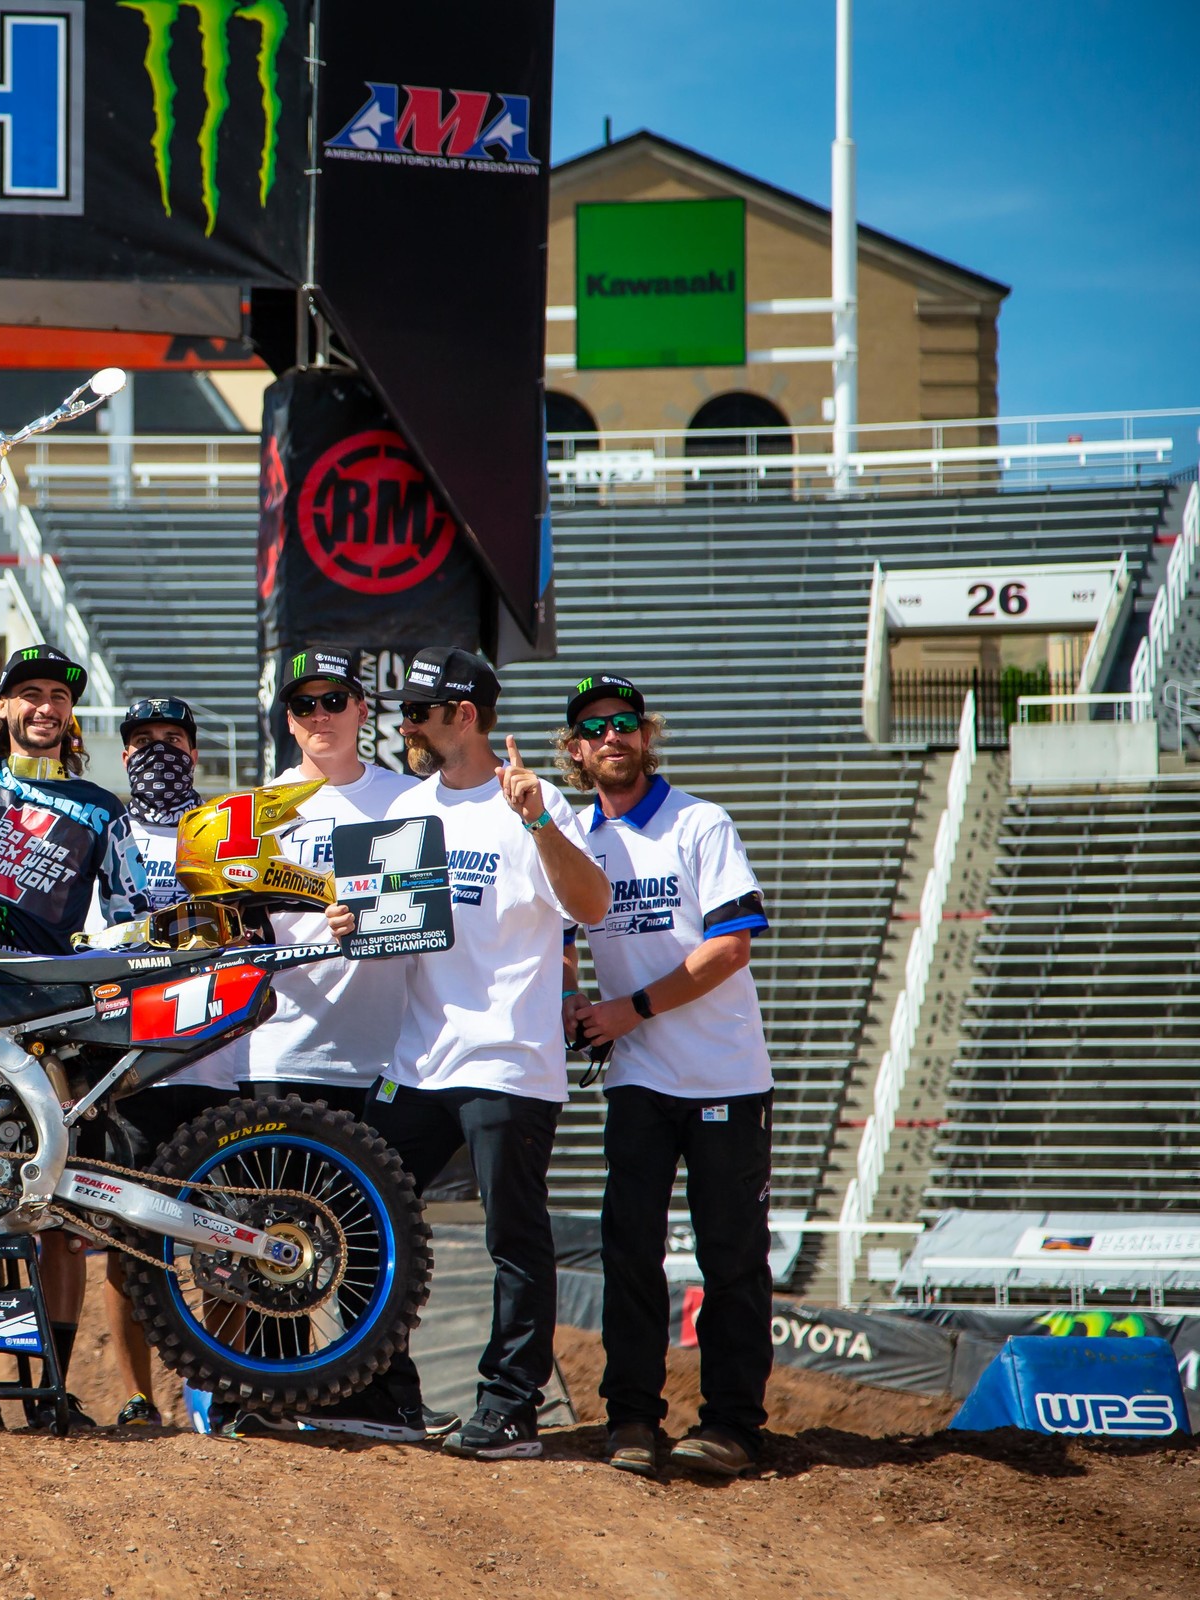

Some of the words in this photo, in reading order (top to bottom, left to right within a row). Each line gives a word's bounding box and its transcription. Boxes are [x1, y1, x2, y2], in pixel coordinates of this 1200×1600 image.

[323, 81, 541, 164] AMA
[324, 148, 381, 164] AMERICAN
[383, 152, 466, 170] MOTORCYCLIST
[468, 158, 540, 176] ASSOCIATION
[586, 269, 736, 298] Kawasaki
[968, 583, 1029, 617] 26
[324, 655, 349, 666] YAMAHA
[418, 660, 441, 674] YAMAHA
[214, 792, 261, 863] 1
[24, 834, 71, 863] AMA
[314, 835, 333, 843] DYLA
[21, 850, 77, 884] WEST
[446, 849, 501, 874] ANDIS
[155, 878, 178, 888] WEST
[228, 868, 254, 879] BELL
[357, 818, 427, 935] 1
[342, 878, 378, 894] AMA
[610, 875, 679, 902] RANDIS
[613, 901, 638, 914] WEST
[379, 913, 407, 925] 2020
[646, 916, 671, 927] THOR
[350, 938, 368, 947] AMA
[368, 932, 422, 945] SUPERCROSS
[422, 929, 446, 940] 250SX
[350, 943, 383, 957] WEST
[385, 937, 447, 953] CHAMPION
[127, 956, 172, 969] YAMAHA
[274, 944, 342, 962] DUNL
[213, 956, 246, 971] Ferrandis
[163, 972, 218, 1035] 1
[207, 1000, 224, 1018] W
[218, 1122, 288, 1148] DUNLOP
[73, 1174, 123, 1195] BRAKING
[74, 1185, 116, 1204] EXCEL
[192, 1212, 238, 1237] VORTEX
[12, 1338, 38, 1346] YAMAHA
[771, 1318, 873, 1362] OYOTA
[1036, 1392, 1178, 1436] WPS
